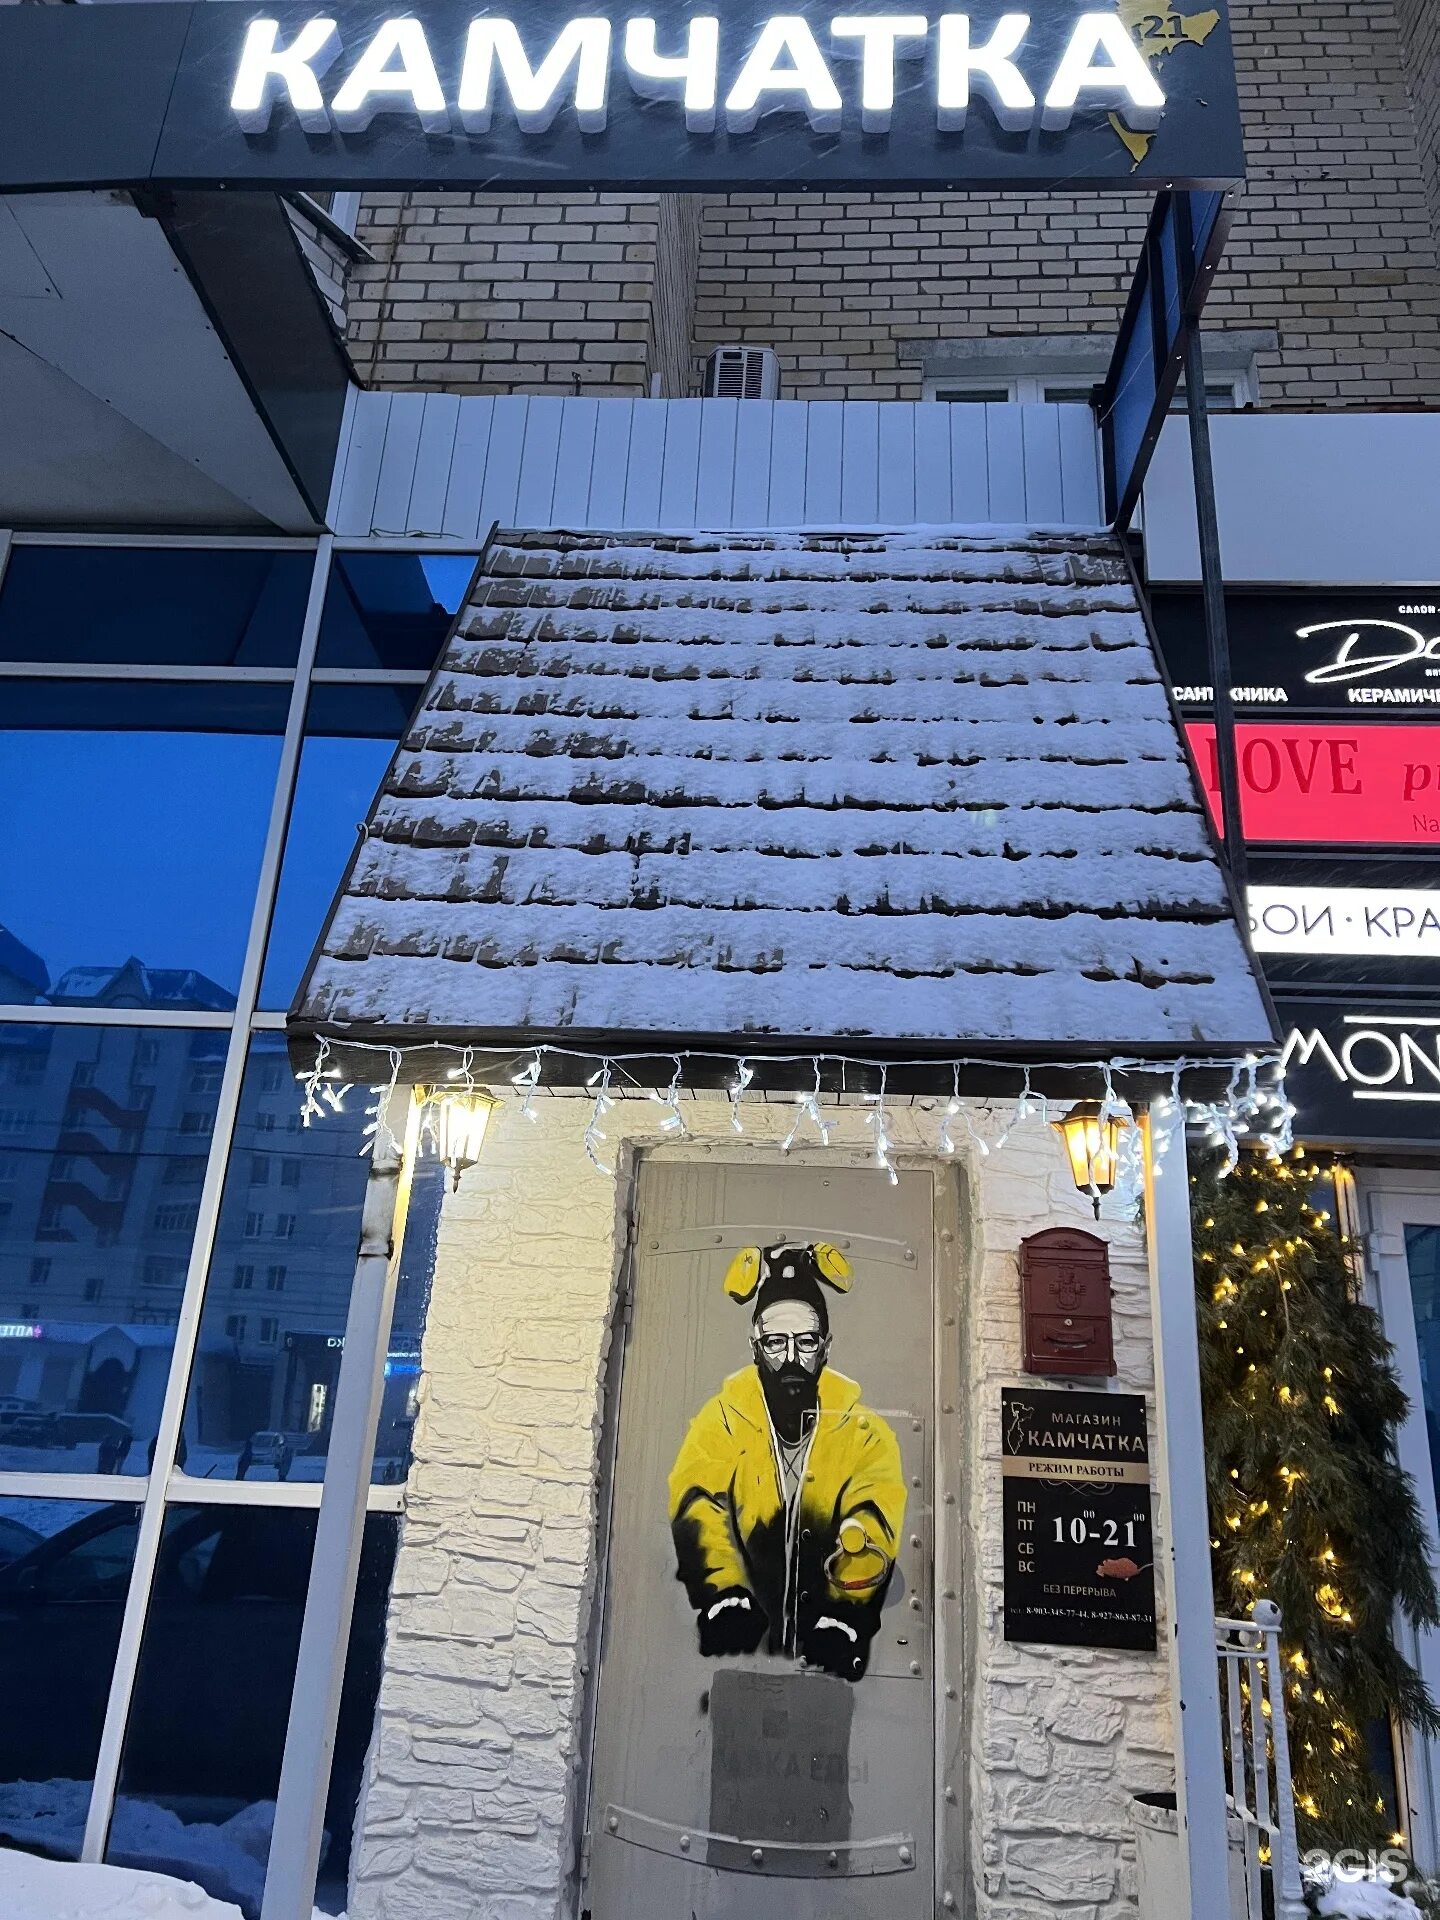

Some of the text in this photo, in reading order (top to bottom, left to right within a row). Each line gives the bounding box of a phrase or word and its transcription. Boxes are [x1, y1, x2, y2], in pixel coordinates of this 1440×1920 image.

[1143, 15, 1189, 38] 21
[230, 13, 1167, 114] КАМЧАТКА
[1398, 605, 1436, 614] САЛОН
[1172, 686, 1288, 702] САНТХНИКА
[1051, 1412, 1121, 1427] МАГАЗИН
[1028, 1430, 1146, 1453] КАМЧАТКА
[1029, 1462, 1124, 1477] РЕЖИМ РАБОТЫ
[1017, 1501, 1036, 1513] ПН
[1017, 1519, 1035, 1531] ПТ
[1017, 1543, 1035, 1554] СБ
[1018, 1561, 1036, 1573] ВС
[1043, 1584, 1117, 1597] БЕЗ ПЕРЕРЫВА
